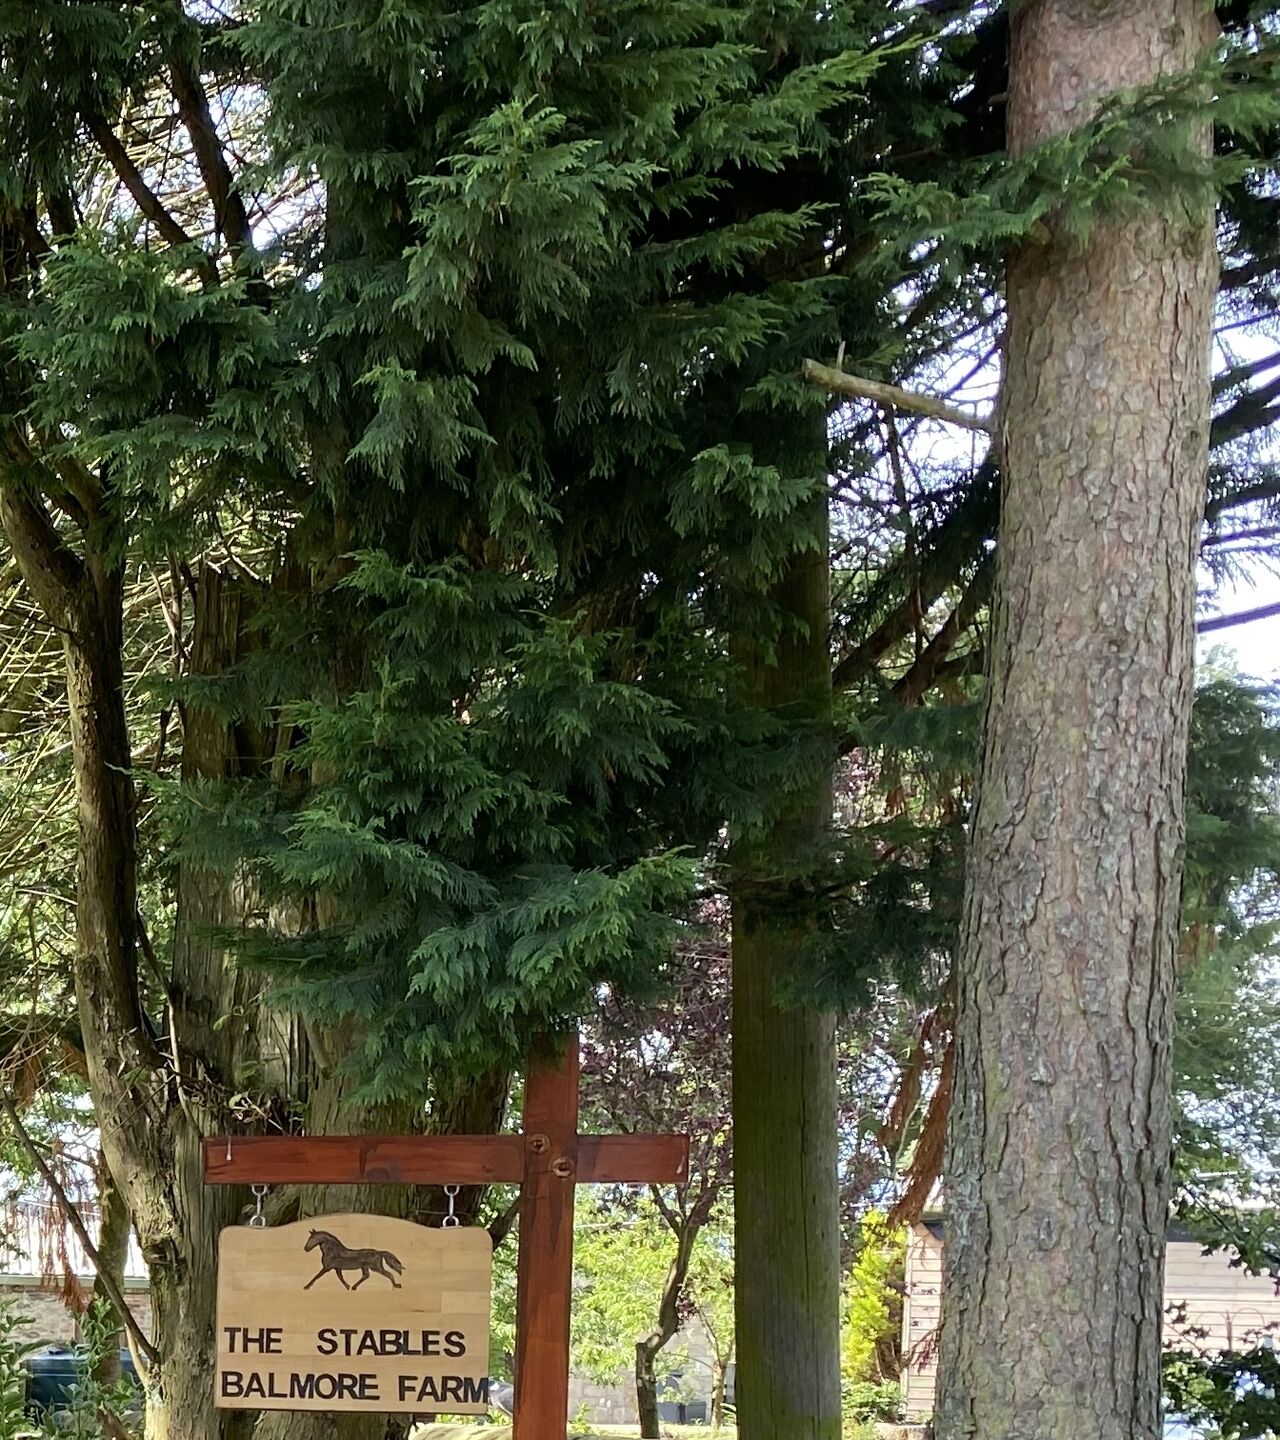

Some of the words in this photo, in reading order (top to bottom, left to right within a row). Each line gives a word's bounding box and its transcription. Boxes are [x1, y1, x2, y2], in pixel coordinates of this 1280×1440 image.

[224, 1326, 283, 1353] THE
[316, 1328, 467, 1357] STABLES
[221, 1370, 381, 1400] BALMORE
[398, 1375, 491, 1404] FARM
